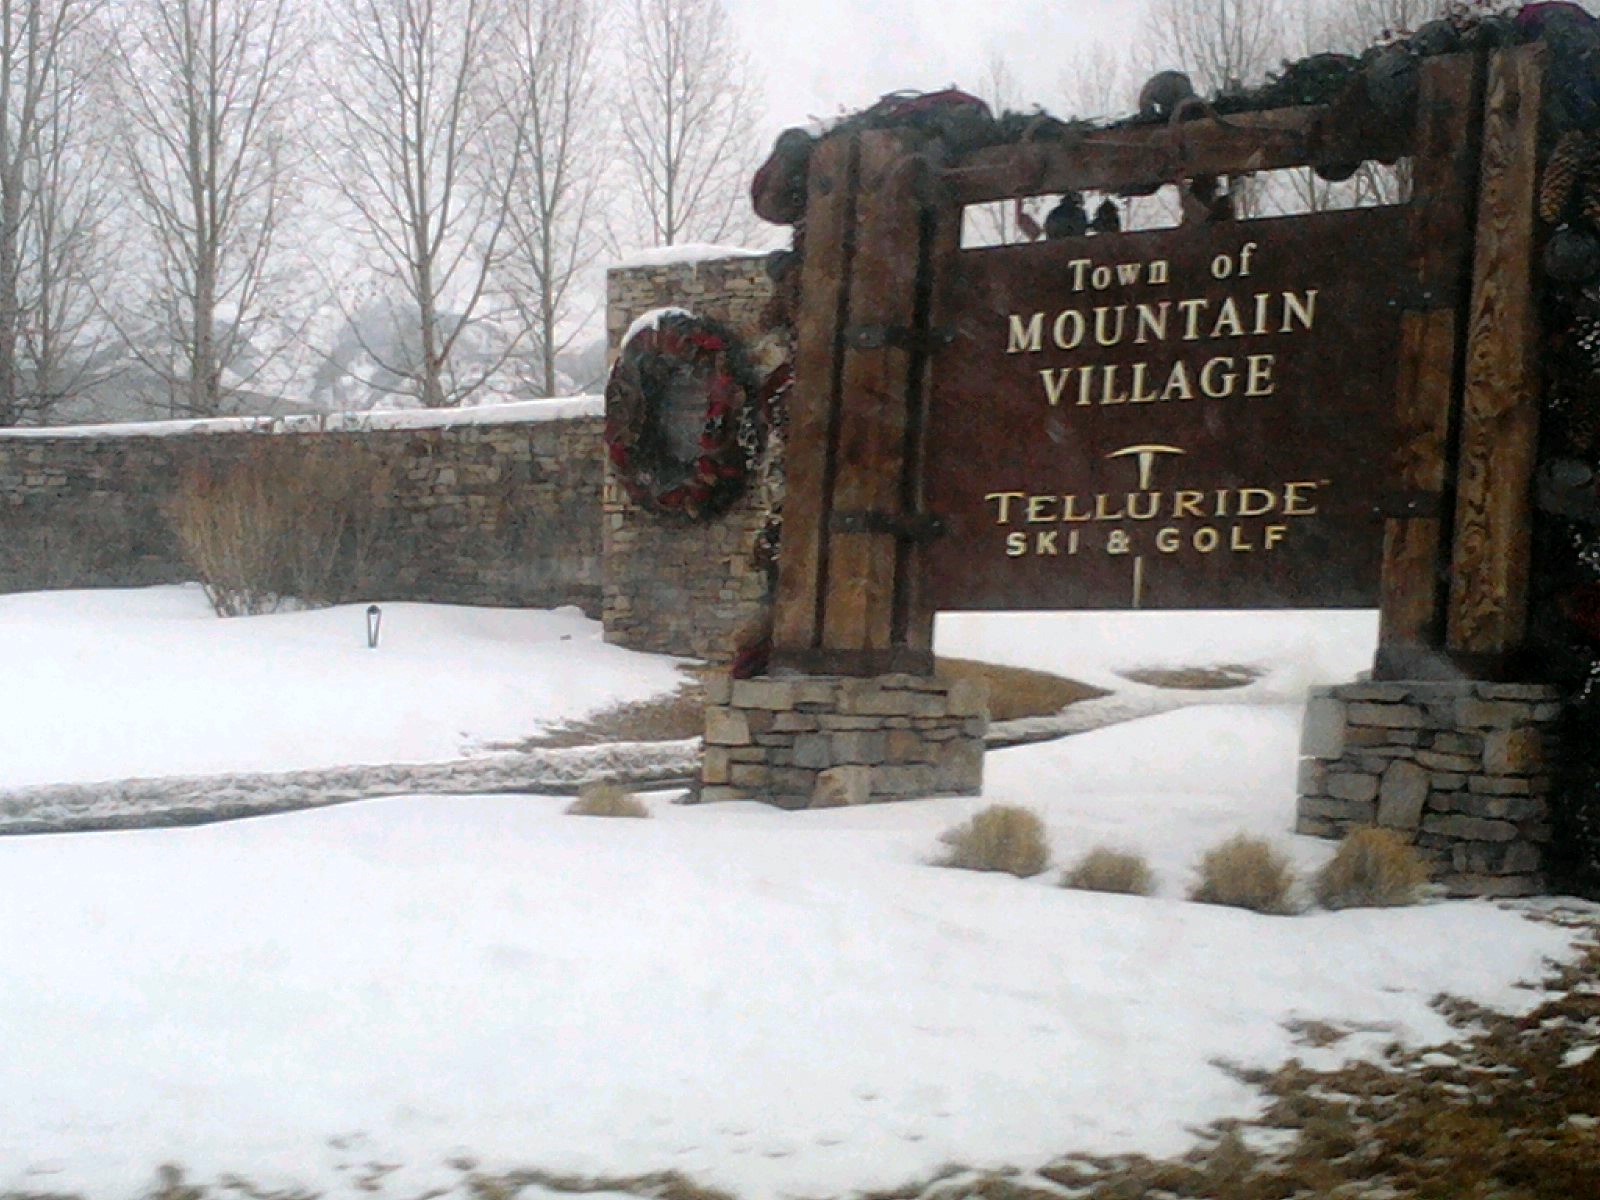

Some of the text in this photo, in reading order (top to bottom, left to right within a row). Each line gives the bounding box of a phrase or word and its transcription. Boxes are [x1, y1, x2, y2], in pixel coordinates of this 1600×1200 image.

[1068, 242, 1257, 292] Town of
[1006, 289, 1319, 354] MOUNTAIN
[1040, 354, 1277, 407] VILLAGE
[984, 481, 1319, 525] TELLURIDE
[1006, 525, 1288, 557] SKI & GOLF
